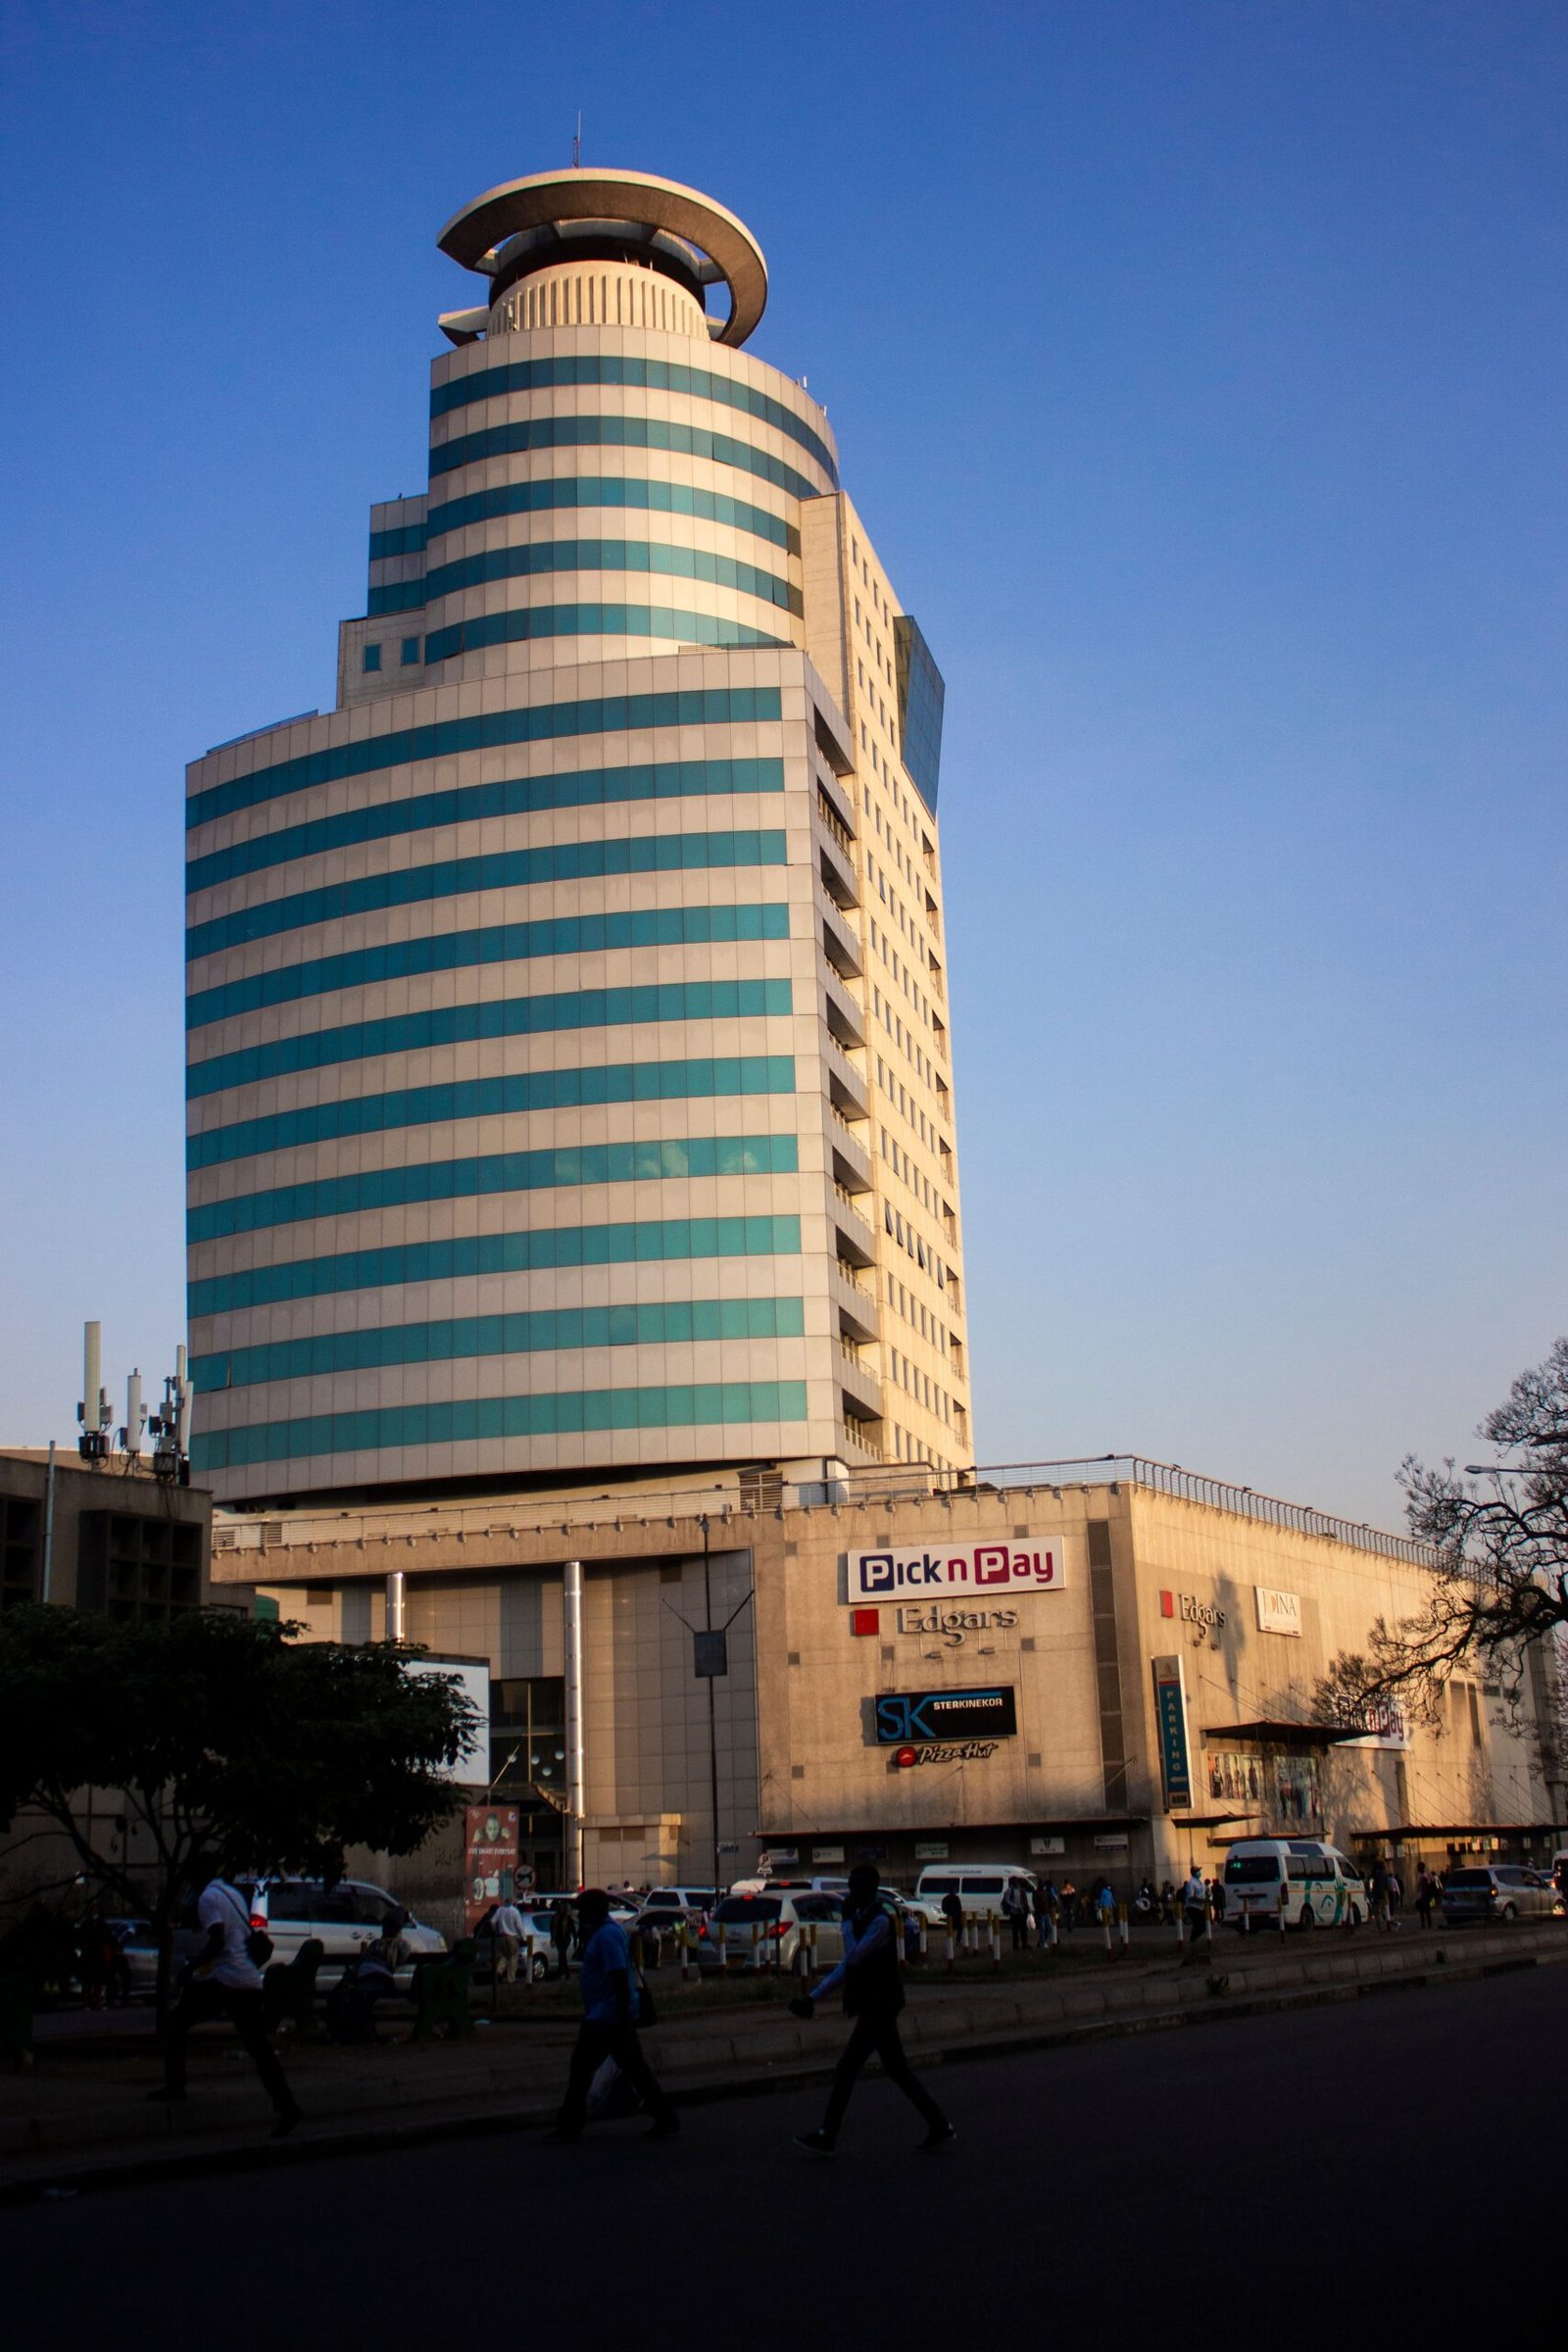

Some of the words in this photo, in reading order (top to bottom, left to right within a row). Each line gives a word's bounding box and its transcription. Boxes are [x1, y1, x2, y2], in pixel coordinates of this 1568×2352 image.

[859, 1554, 943, 1592] Pick
[948, 1558, 967, 1582] n
[974, 1546, 1053, 1584] Pay
[900, 1605, 1018, 1646] Edgars
[1179, 1593, 1226, 1638] Edgars
[878, 1694, 937, 1740] SK
[1166, 1690, 1181, 1772] PARKING
[919, 1745, 963, 1765] Pizza
[964, 1741, 999, 1759] Hut
